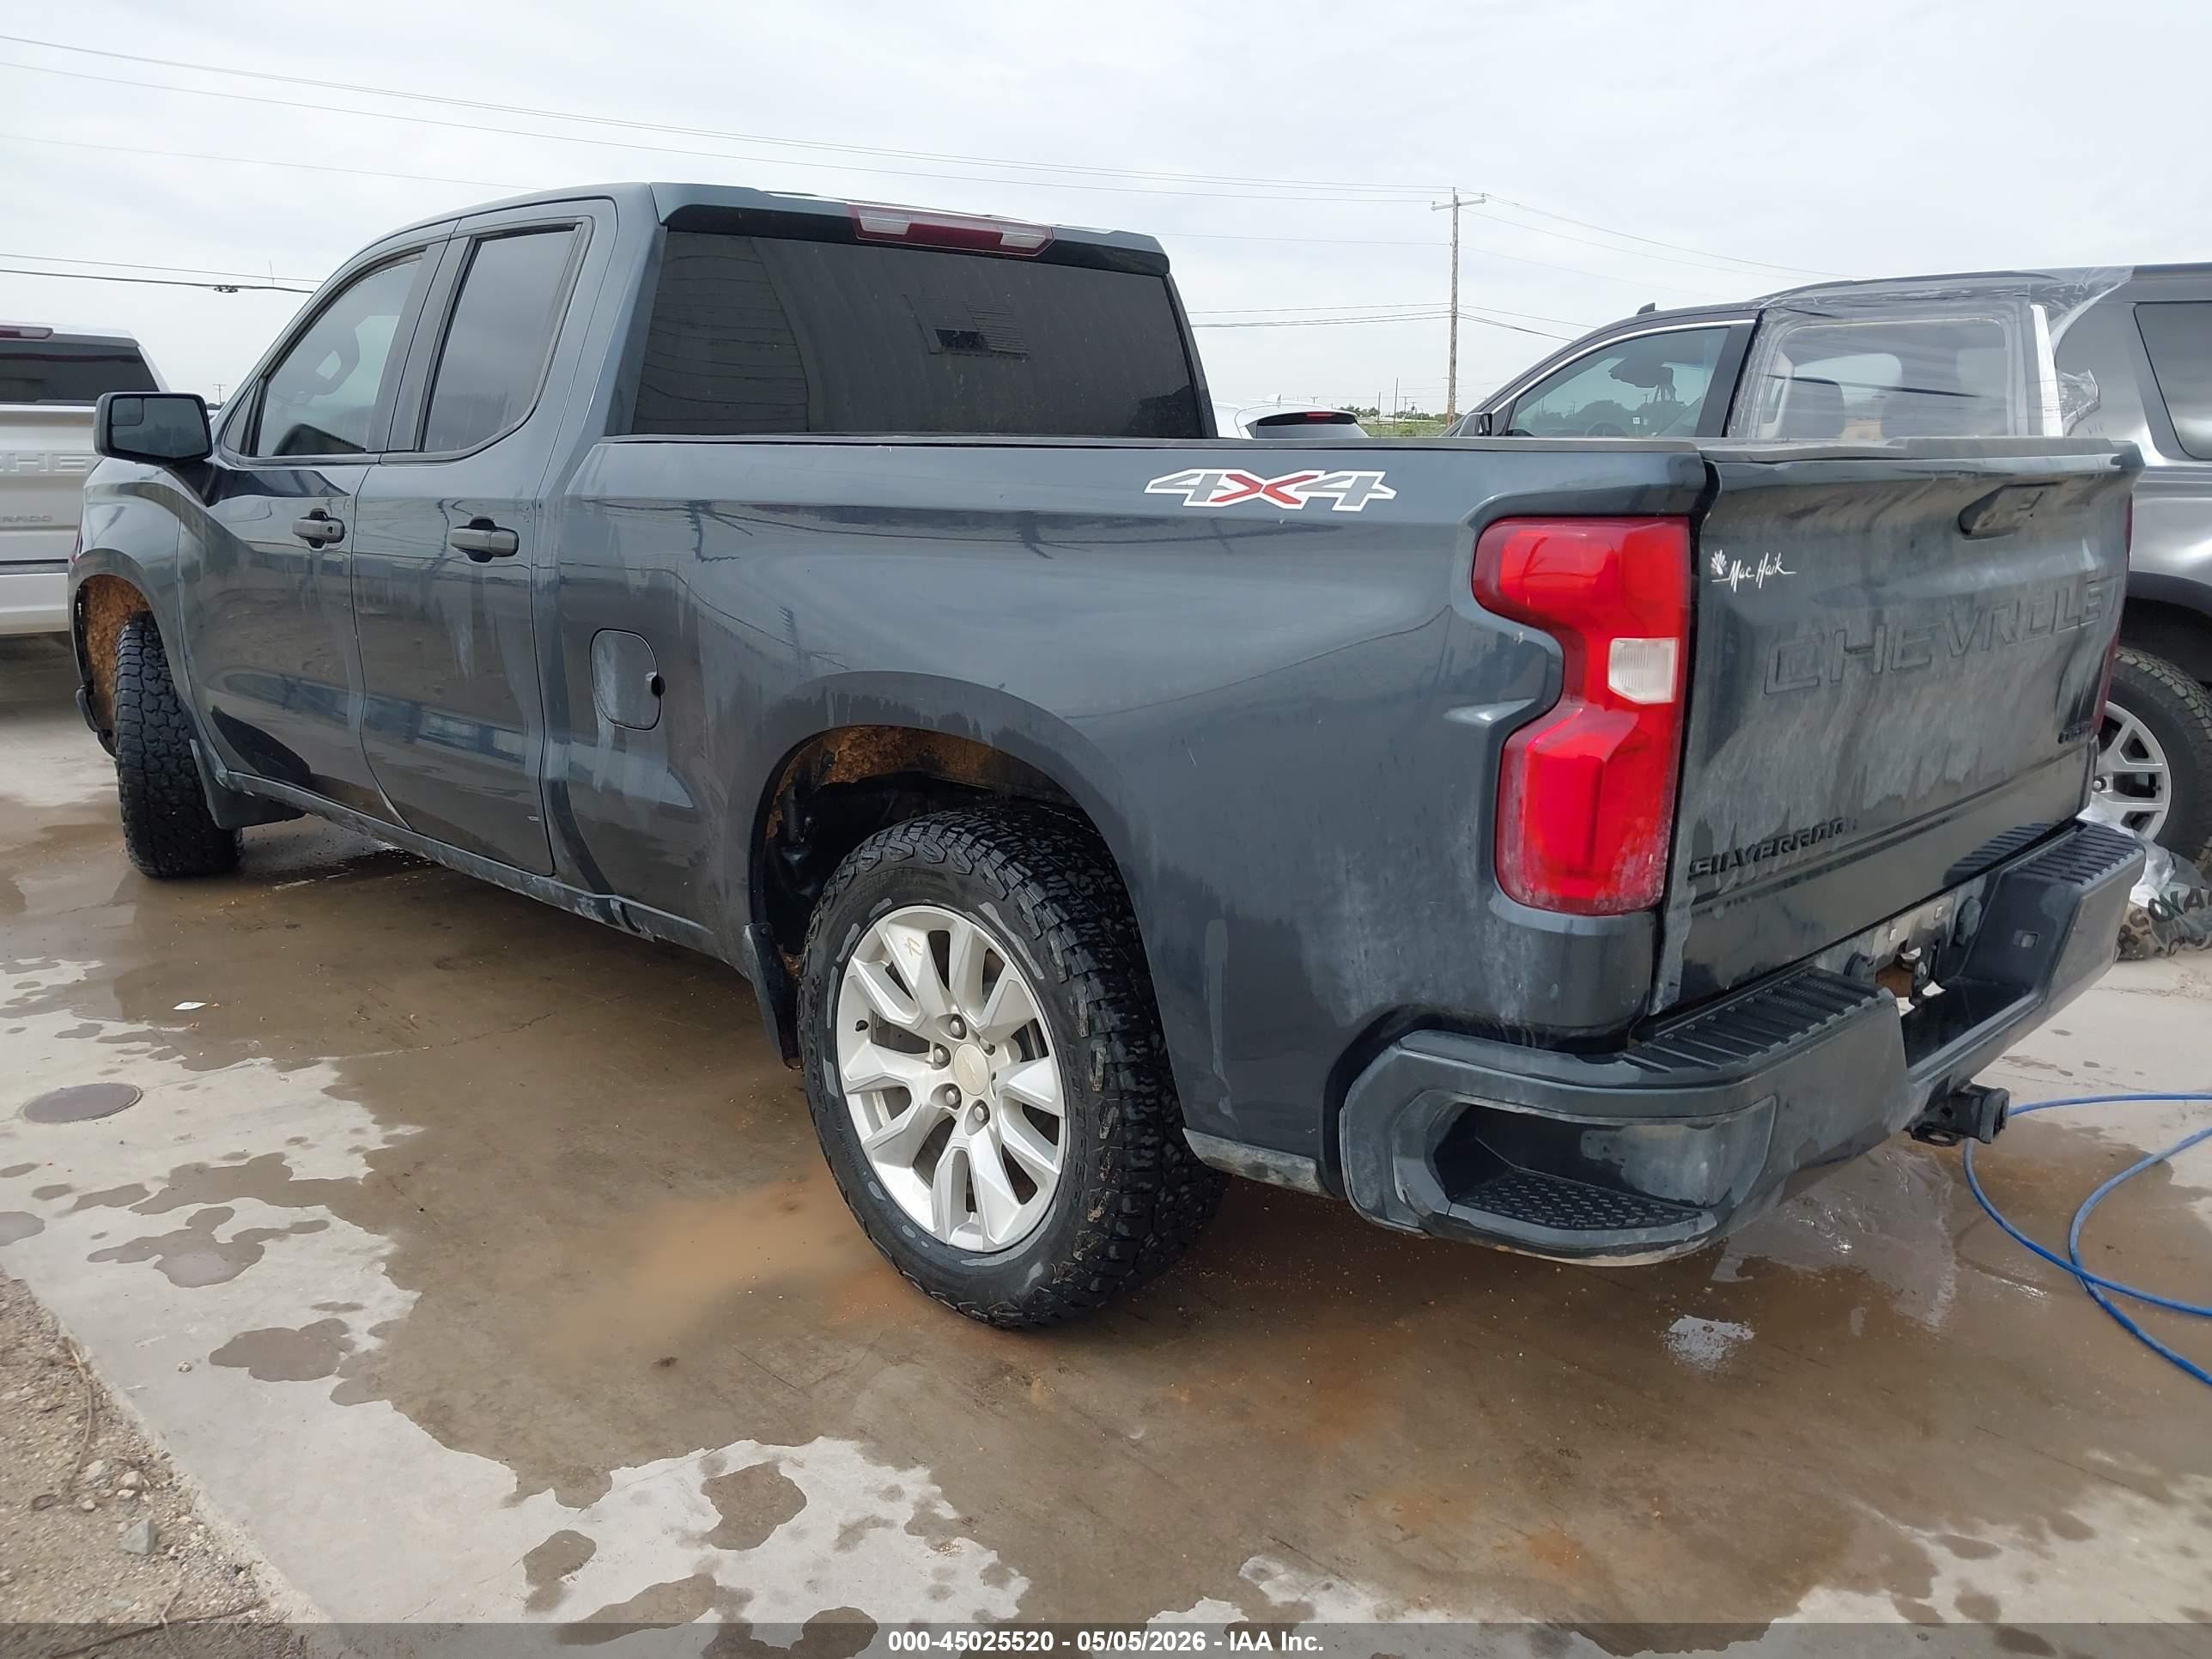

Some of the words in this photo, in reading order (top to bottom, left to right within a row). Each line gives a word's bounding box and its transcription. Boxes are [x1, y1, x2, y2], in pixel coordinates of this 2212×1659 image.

[1711, 559, 1754, 592] Mac
[1756, 552, 1797, 589] Haik
[1764, 570, 2124, 695] CHEVROLET
[1687, 817, 1855, 881] SILVERADO
